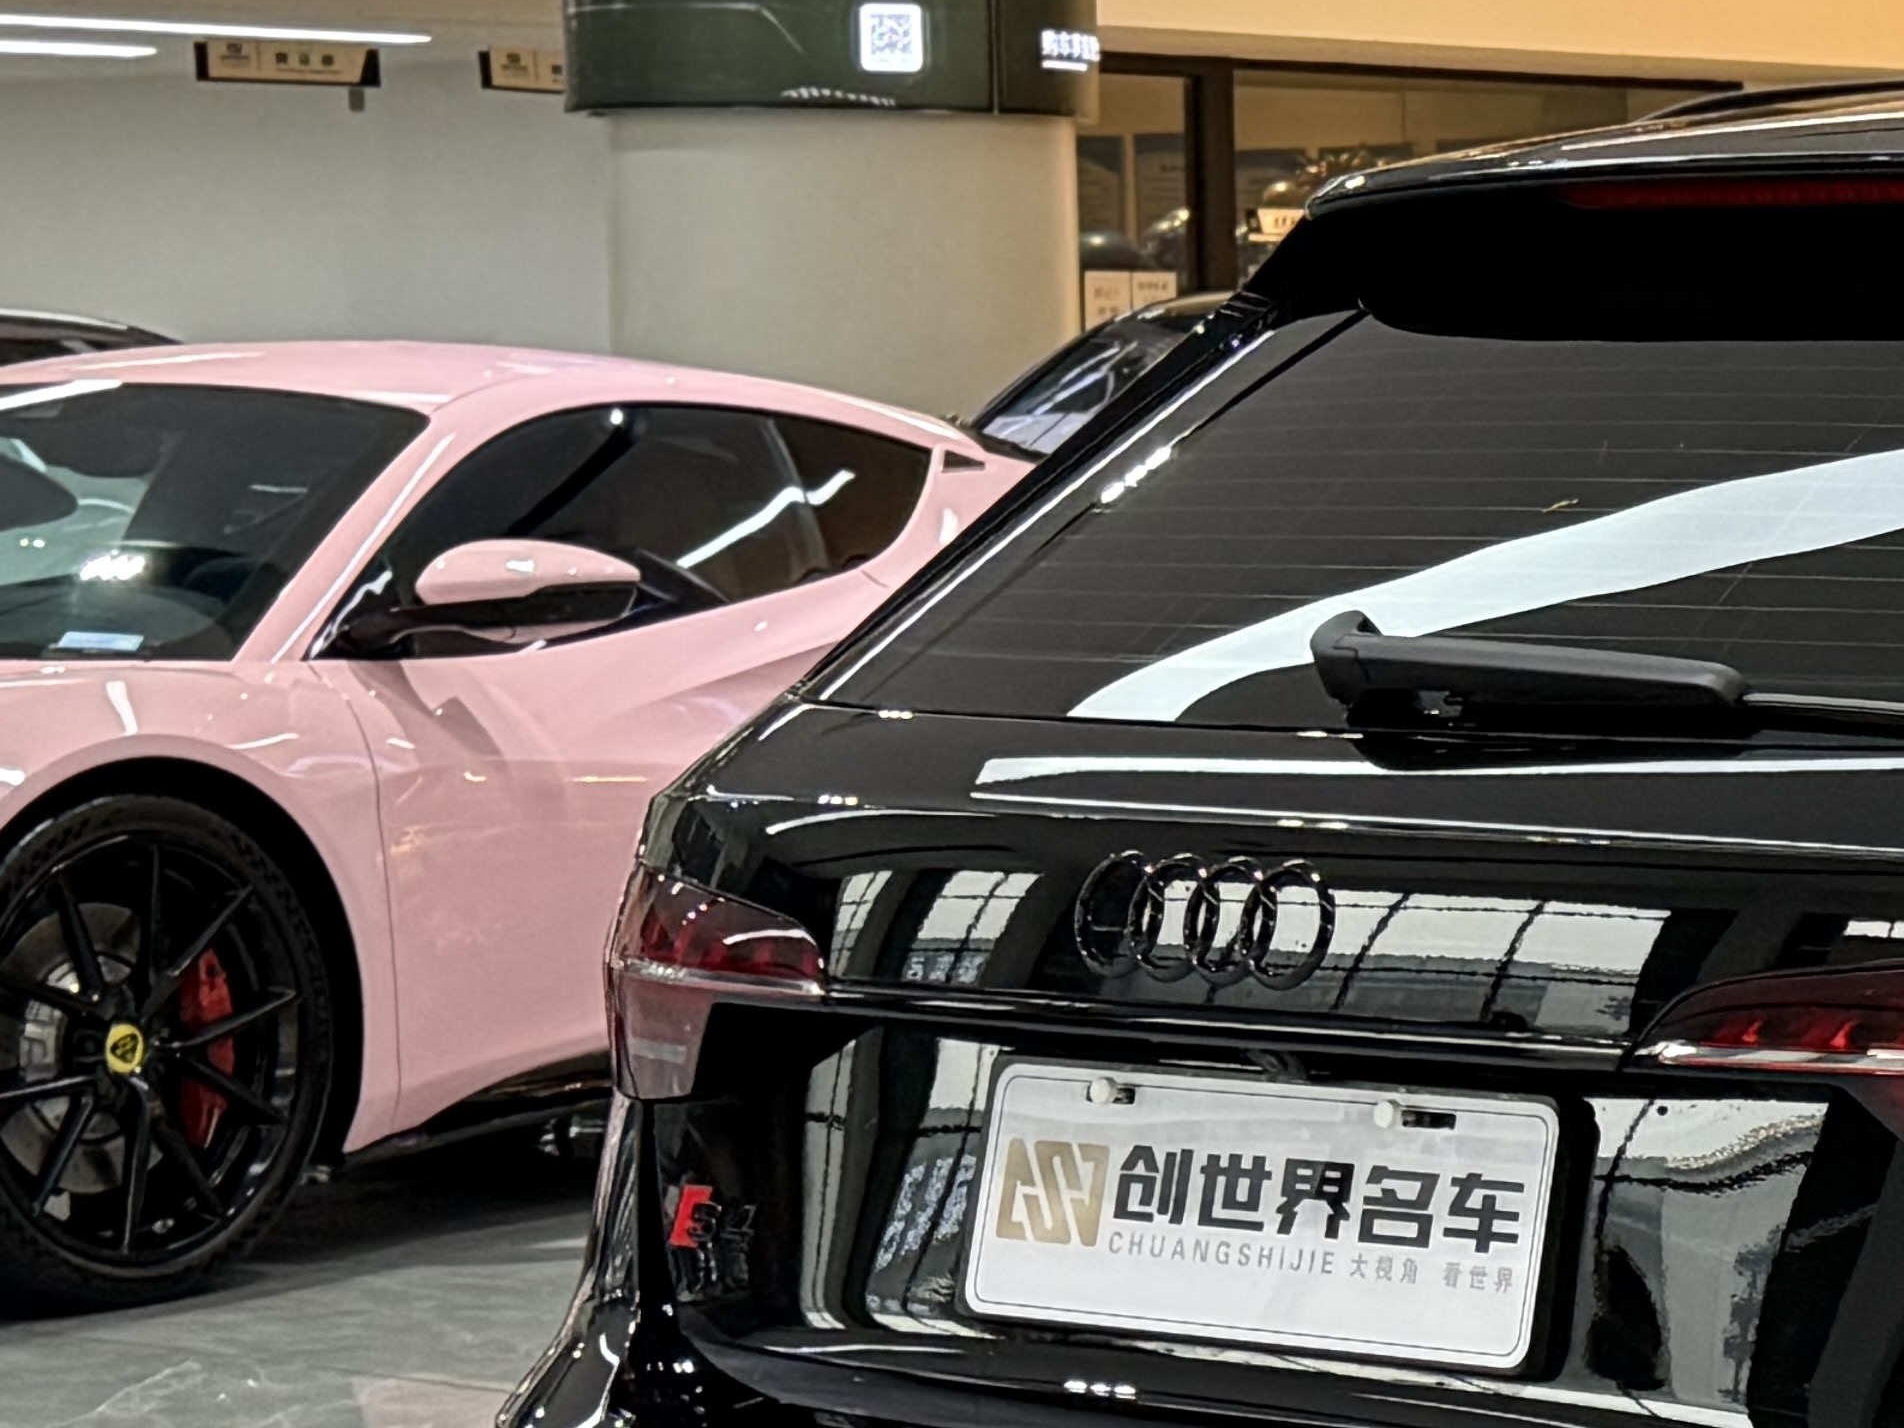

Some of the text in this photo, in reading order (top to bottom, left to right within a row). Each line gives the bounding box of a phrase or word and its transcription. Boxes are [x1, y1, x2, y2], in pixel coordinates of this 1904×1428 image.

[1113, 1144, 1525, 1254] 创世界名车
[1108, 1231, 1515, 1293] CHUANGSHIJIE 大视角 看世界
